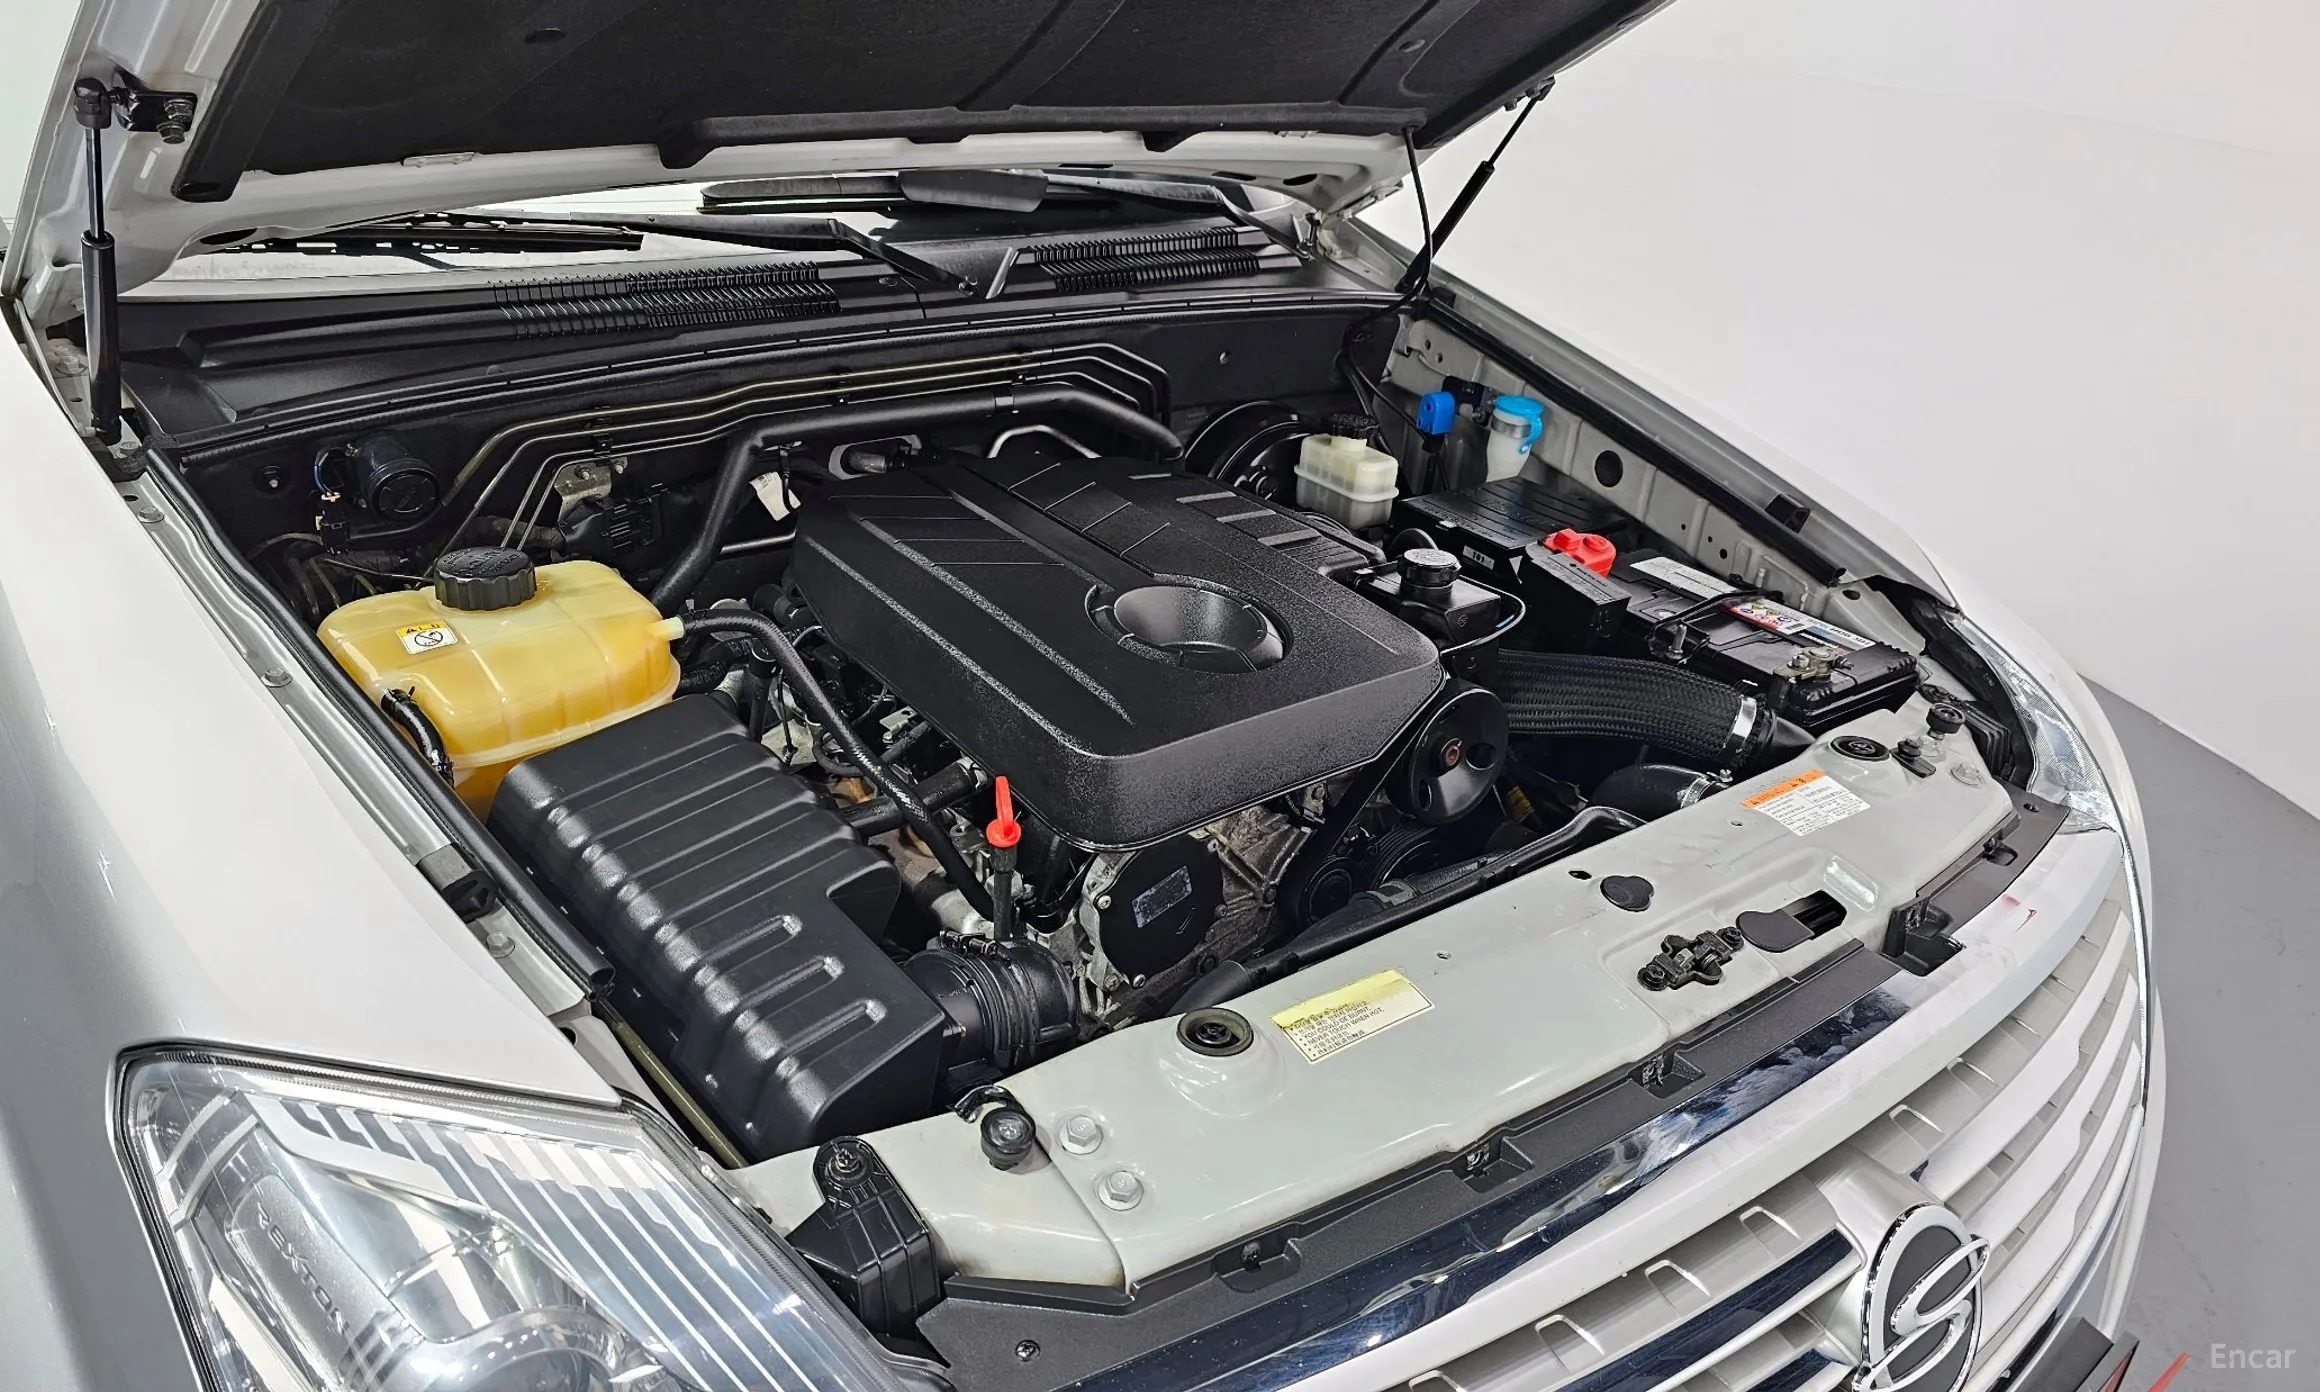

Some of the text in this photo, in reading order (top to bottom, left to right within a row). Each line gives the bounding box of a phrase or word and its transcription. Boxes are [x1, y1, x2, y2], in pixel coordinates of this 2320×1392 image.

[1304, 1028, 1317, 1039] YOU
[1317, 1020, 1340, 1033] COULD
[1307, 1031, 1329, 1045] NEVER
[1329, 1021, 1352, 1035] TOUCH
[1352, 1013, 1371, 1026] WHEN
[257, 1202, 350, 1335] REXTON
